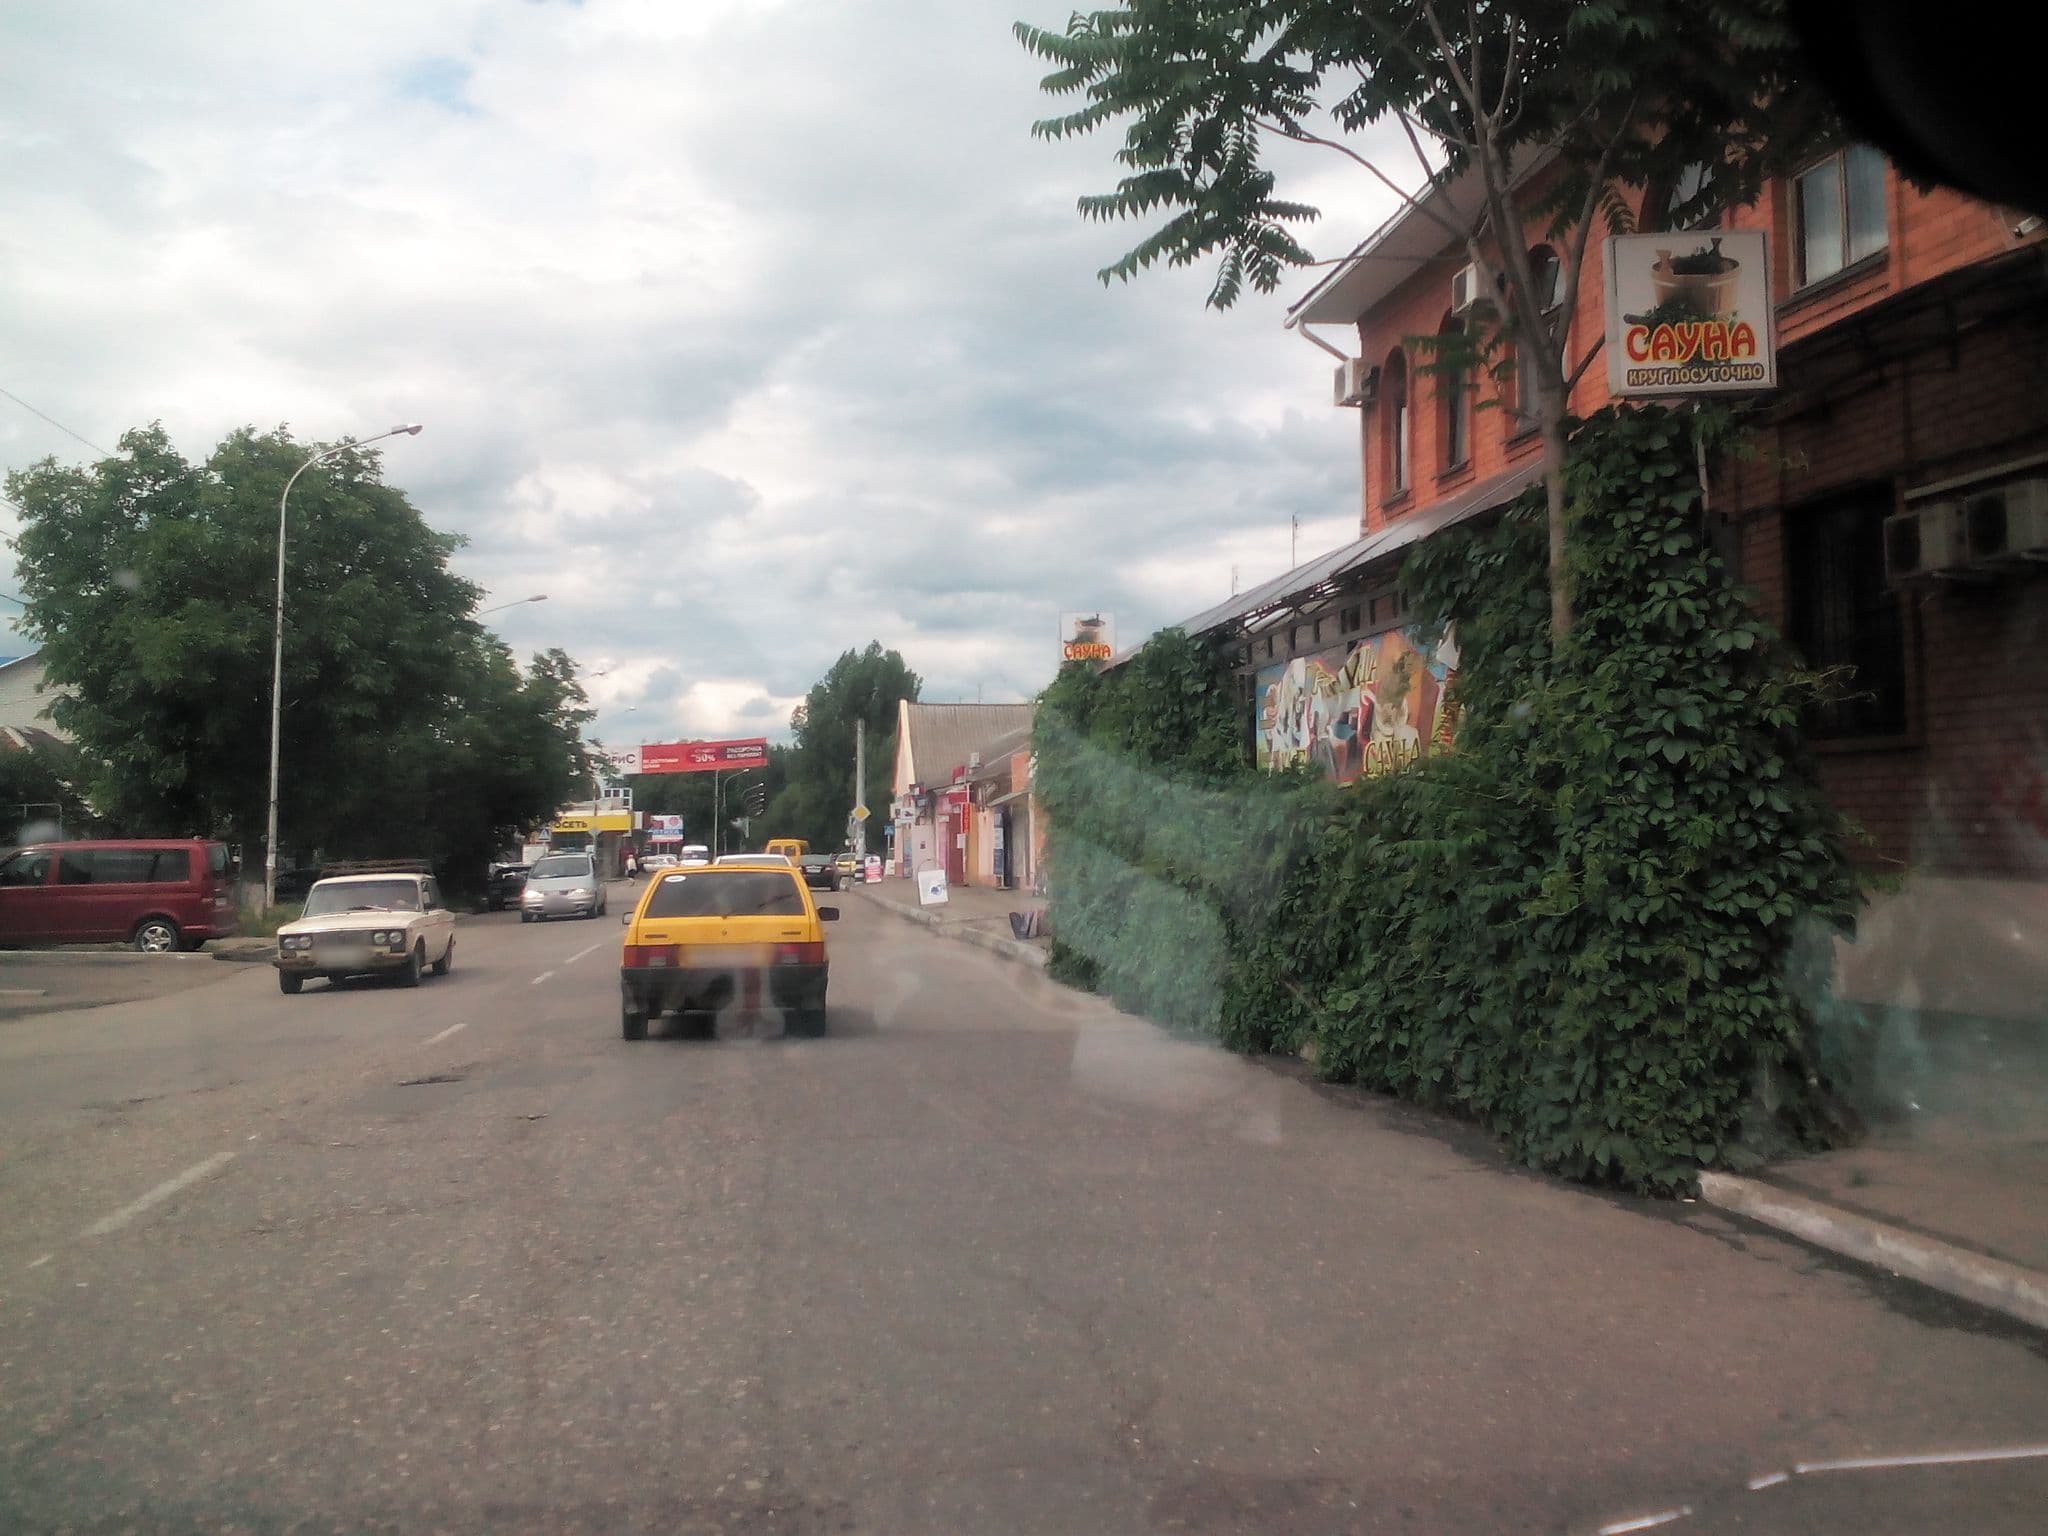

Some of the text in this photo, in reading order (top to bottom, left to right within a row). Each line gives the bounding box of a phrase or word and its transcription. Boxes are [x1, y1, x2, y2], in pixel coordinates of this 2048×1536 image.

[1626, 321, 1756, 363] САУНА
[1627, 364, 1764, 387] КРУГЛОСУТОЧНО
[1064, 644, 1111, 659] САУНА
